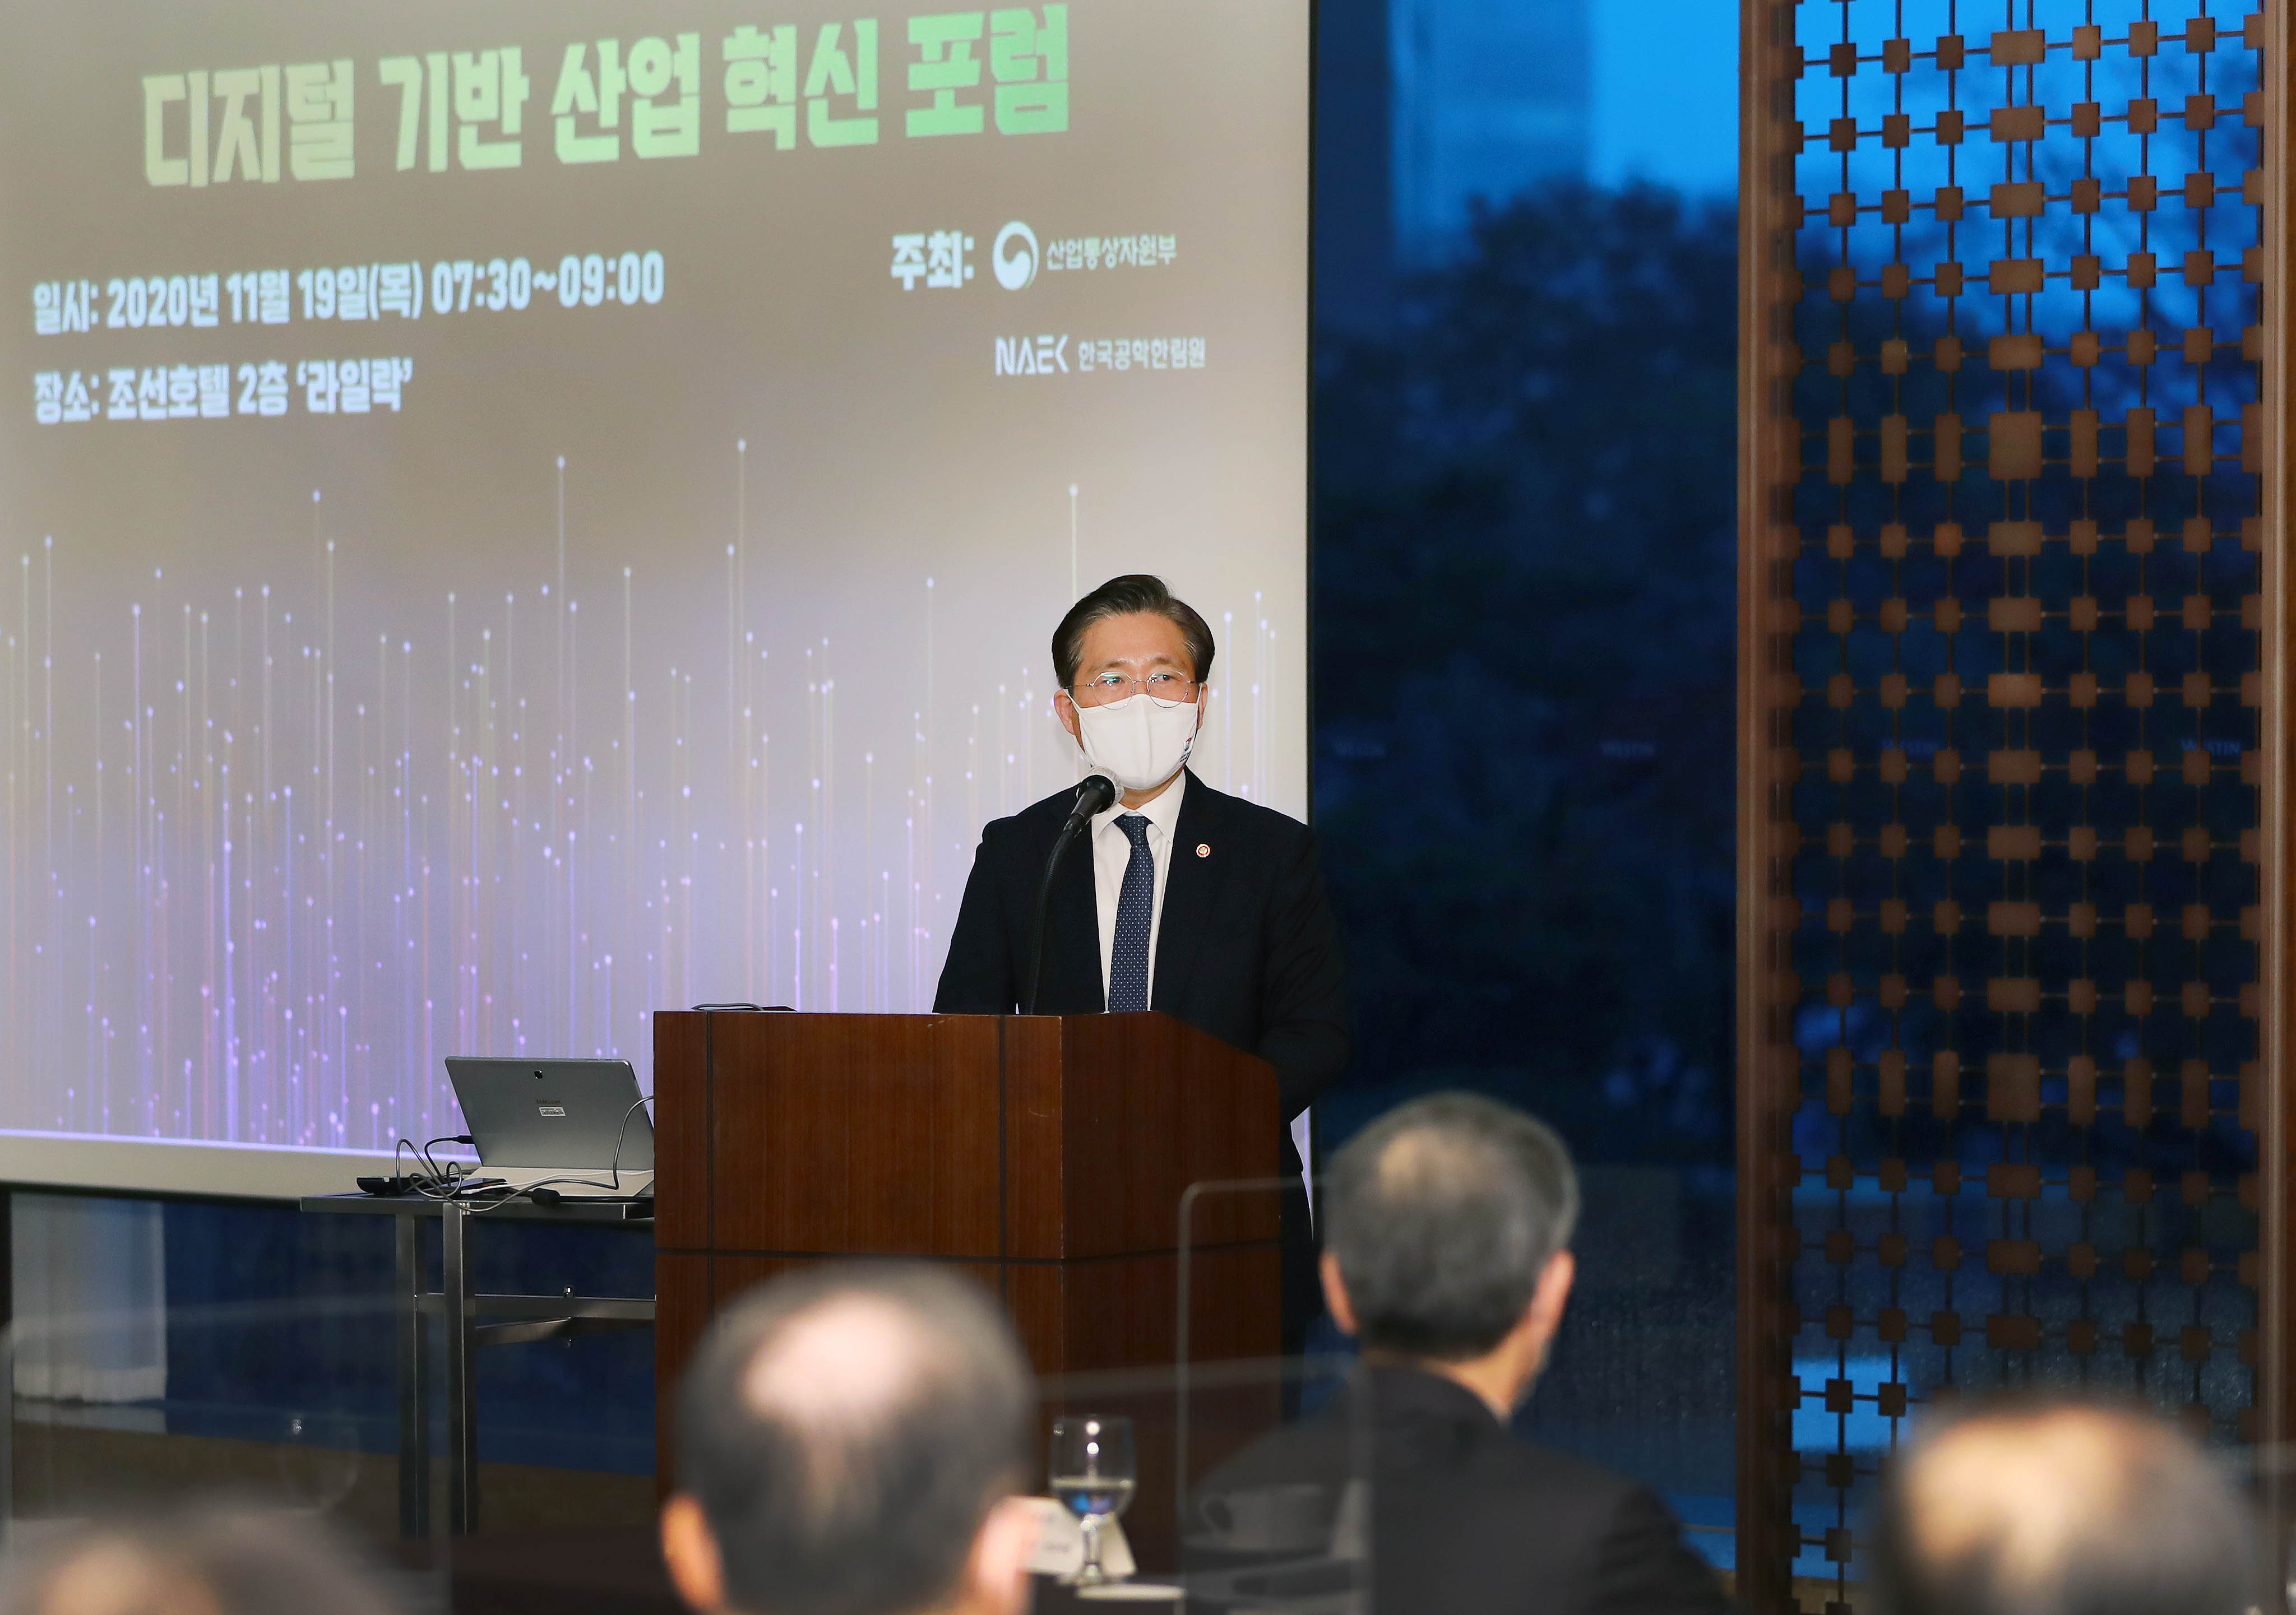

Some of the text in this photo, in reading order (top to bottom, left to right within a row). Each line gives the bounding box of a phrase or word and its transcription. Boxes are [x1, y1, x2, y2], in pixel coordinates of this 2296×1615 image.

[141, 2, 1069, 188] 디지털 기반 산업 혁신 포럼
[32, 250, 665, 335] 일시: 2020년 11월 19일(목) 07:30~09:00
[890, 229, 1178, 291] 주최: 산업통상자원부
[994, 334, 1206, 376] NAEK 한국공학한림원
[34, 370, 100, 425] 장소:
[106, 363, 230, 421] 조선호텔
[237, 359, 289, 416] 2층
